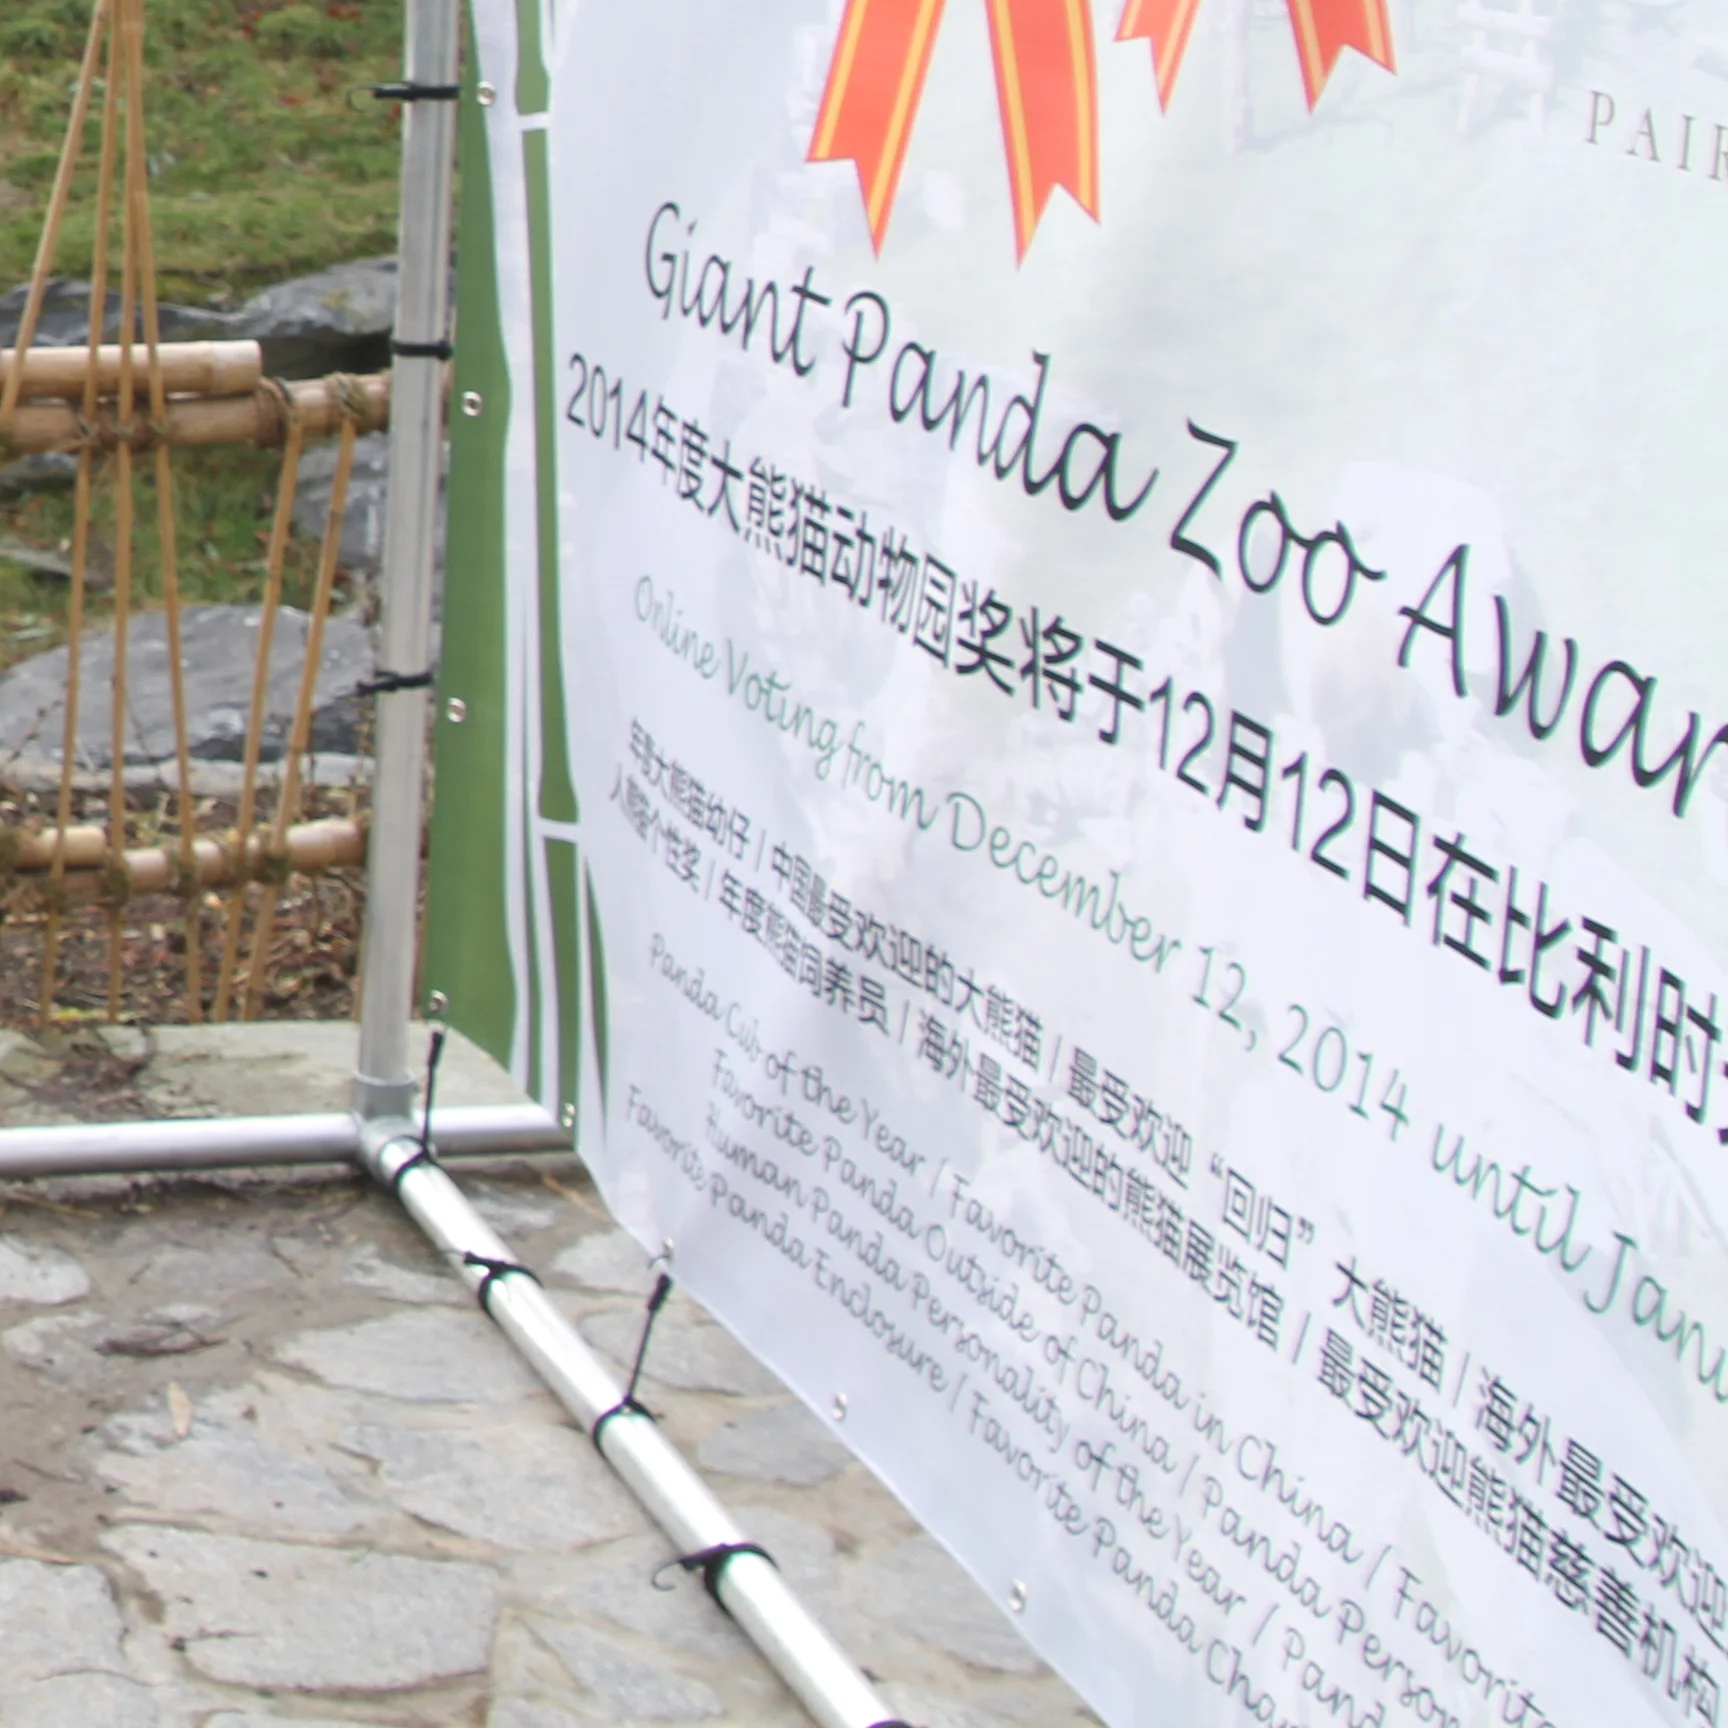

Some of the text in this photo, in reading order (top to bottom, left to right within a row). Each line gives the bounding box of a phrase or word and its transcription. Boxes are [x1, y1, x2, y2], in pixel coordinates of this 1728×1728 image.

[645, 201, 832, 377] Giant
[842, 291, 1160, 522] Panda
[1169, 417, 1388, 626] Zoo
[566, 352, 1728, 1144] 2014年度大熊猫动物园奖将于12月12日在比利时
[635, 574, 721, 680] Online
[727, 638, 844, 781] Voting
[841, 720, 939, 831] from
[946, 791, 1182, 973] December
[1190, 944, 1257, 1053] 12,
[1276, 1003, 1411, 1142] 2014
[1431, 1122, 1593, 1273] until
[771, 841, 1044, 1076] 中国最受欢迎的大熊猫
[649, 931, 724, 1021] Panda
[726, 1000, 763, 1063] Cub
[766, 1050, 798, 1097] of
[801, 1063, 858, 1125] the
[861, 1096, 927, 1177] Year
[950, 1172, 1078, 1306] Favorite
[1080, 1283, 1191, 1411] Panda
[1193, 1391, 1234, 1456] in
[1237, 1433, 1364, 1565] China
[1393, 1563, 1558, 1728] Favorit
[706, 1100, 809, 1209] Human
[810, 1185, 909, 1292] Panda
[912, 1271, 1071, 1454] Personality
[1074, 1439, 1117, 1493] of
[1116, 1463, 1170, 1540] the
[1173, 1511, 1248, 1617] Year
[709, 1171, 814, 1270] Panda
[813, 1246, 950, 1394] Enclosure
[968, 1388, 1090, 1536] Favorite
[1093, 1515, 1204, 1655] Panda
[711, 1047, 820, 1157] Favorite
[822, 1134, 923, 1240] Panda
[925, 1222, 1041, 1343] Outside
[1044, 1334, 1078, 1386] of
[1077, 1357, 1179, 1474] China
[1201, 1475, 1333, 1619] Panda
